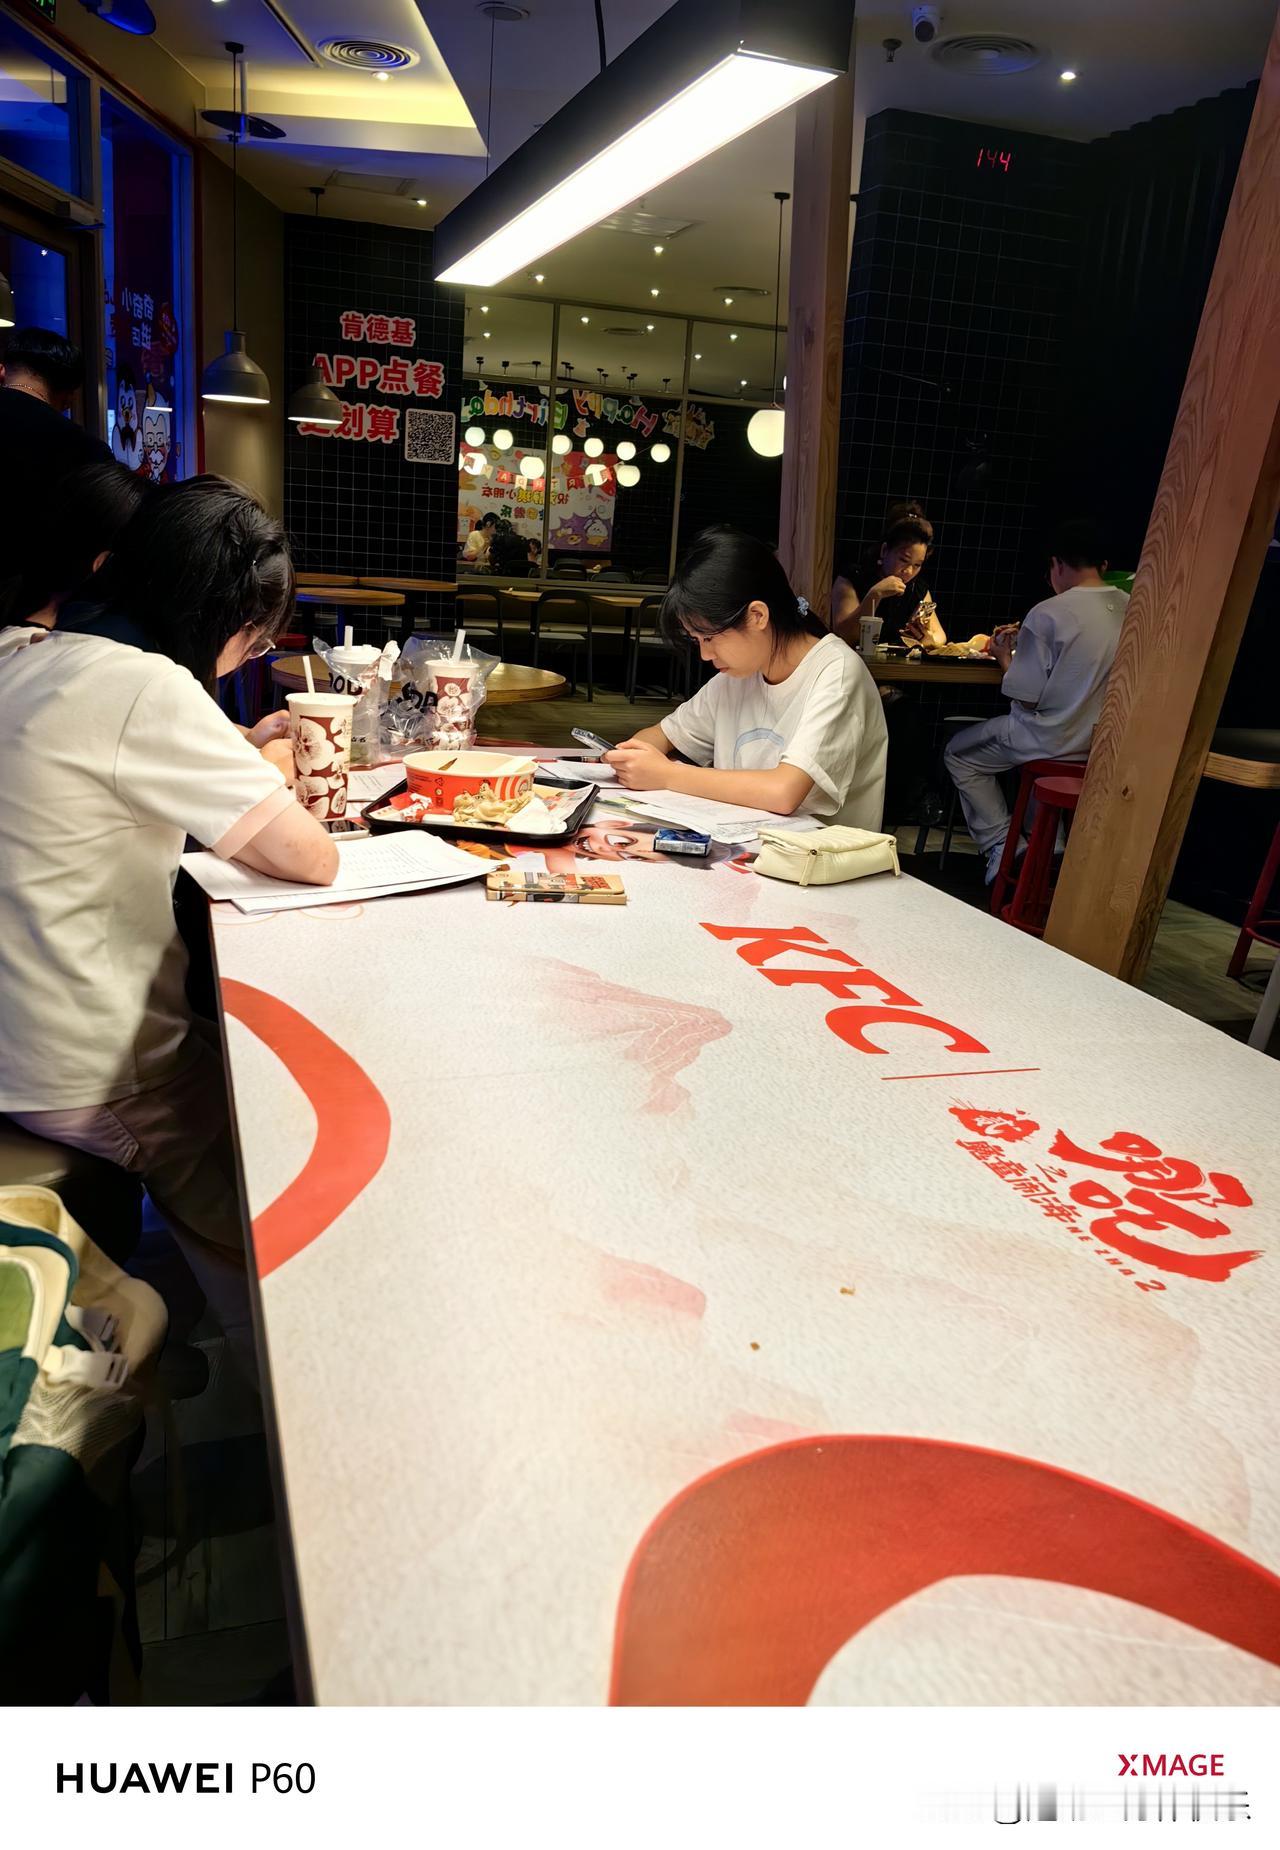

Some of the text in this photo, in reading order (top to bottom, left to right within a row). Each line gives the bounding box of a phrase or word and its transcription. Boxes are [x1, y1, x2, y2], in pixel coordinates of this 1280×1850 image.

[340, 311, 416, 347] 肯德基
[297, 403, 400, 443] 划算
[698, 922, 991, 1054] KFC
[955, 1139, 1082, 1223] 魔童闹海
[1047, 1128, 1267, 1283] 哪吒
